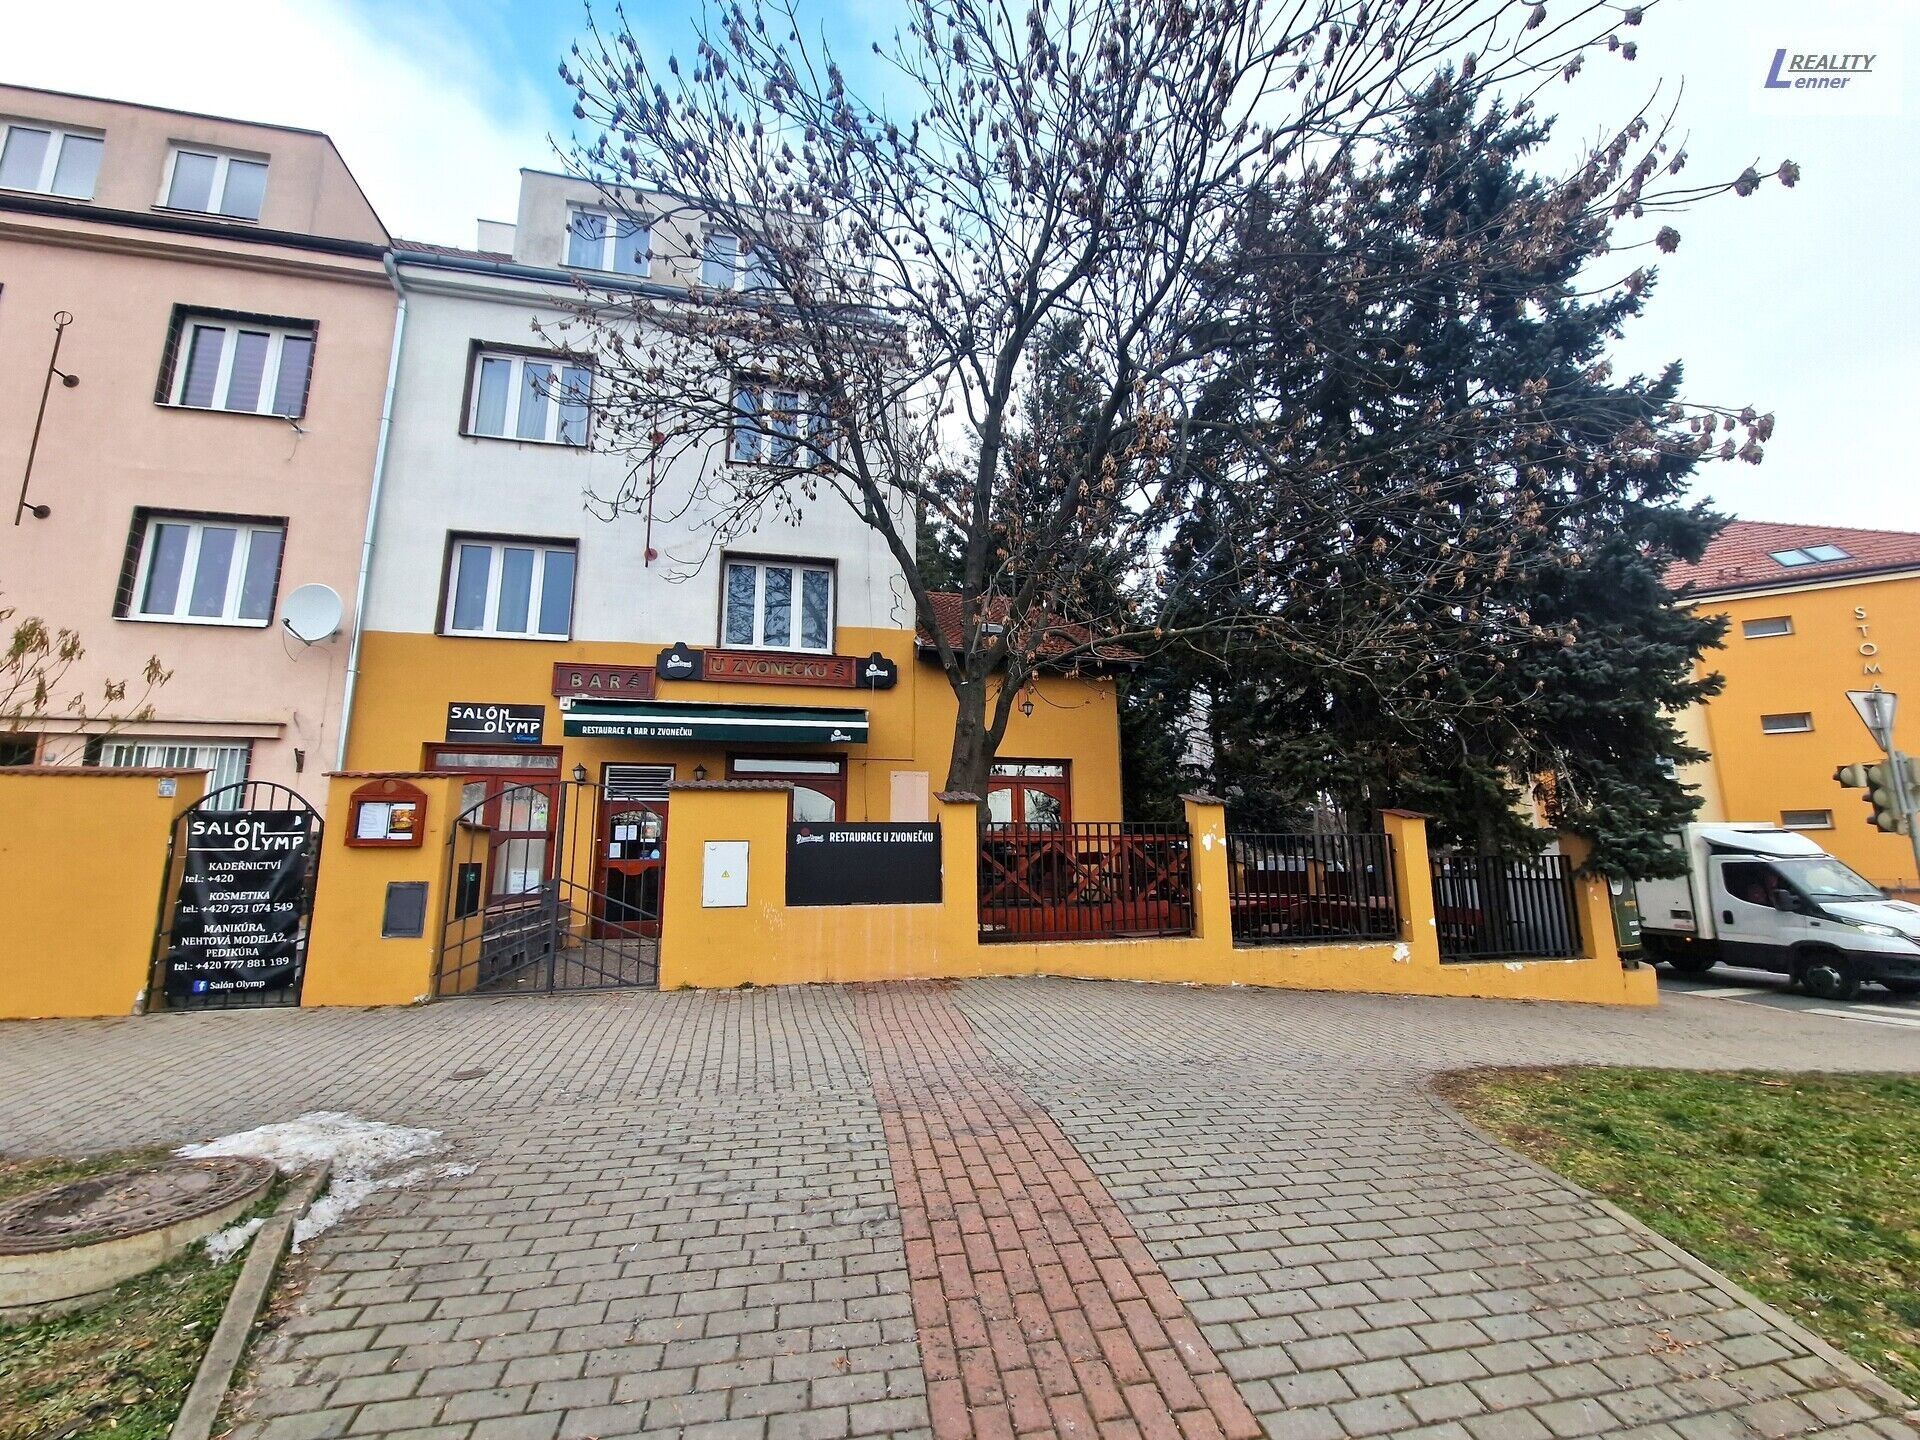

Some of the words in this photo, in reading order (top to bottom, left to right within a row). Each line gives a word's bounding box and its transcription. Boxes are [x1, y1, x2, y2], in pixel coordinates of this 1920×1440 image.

[711, 658, 725, 672] U
[732, 657, 828, 678] ZVONEČKU
[570, 672, 621, 689] BAR
[450, 706, 510, 720] SALÓN
[484, 721, 540, 734] OLYMP
[582, 726, 625, 735] RESTAURACE
[626, 726, 632, 735] A
[634, 727, 648, 736] BAR
[650, 727, 656, 736] U
[657, 727, 693, 737] ZVONEČKU
[191, 819, 265, 835] SALÓN
[829, 831, 882, 843] RESTAURACE
[883, 832, 889, 843] U
[890, 829, 934, 843] ZVONEČKU
[234, 836, 304, 851] OLYMP
[208, 859, 282, 871] KADEŘNICTVÍ
[185, 874, 204, 883] tel.:
[207, 874, 234, 883] +420
[209, 891, 270, 901] KOSMETIKA
[182, 904, 199, 913] tel.:
[201, 904, 229, 913] +420
[230, 904, 249, 914] 731
[252, 903, 271, 913] 074
[273, 902, 294, 912] 549
[203, 923, 266, 934] MANIKÚRA,
[181, 935, 231, 946] NEHTOVÁ
[233, 933, 287, 945] MODELÁŽ,
[206, 948, 259, 958] PEDIKÚRA
[174, 962, 193, 971] tel.:
[195, 961, 221, 970] +420
[223, 961, 244, 969] 777
[247, 959, 266, 968] 881
[270, 957, 290, 966] 189
[210, 981, 234, 990] Salón
[236, 980, 266, 989] Olymp
